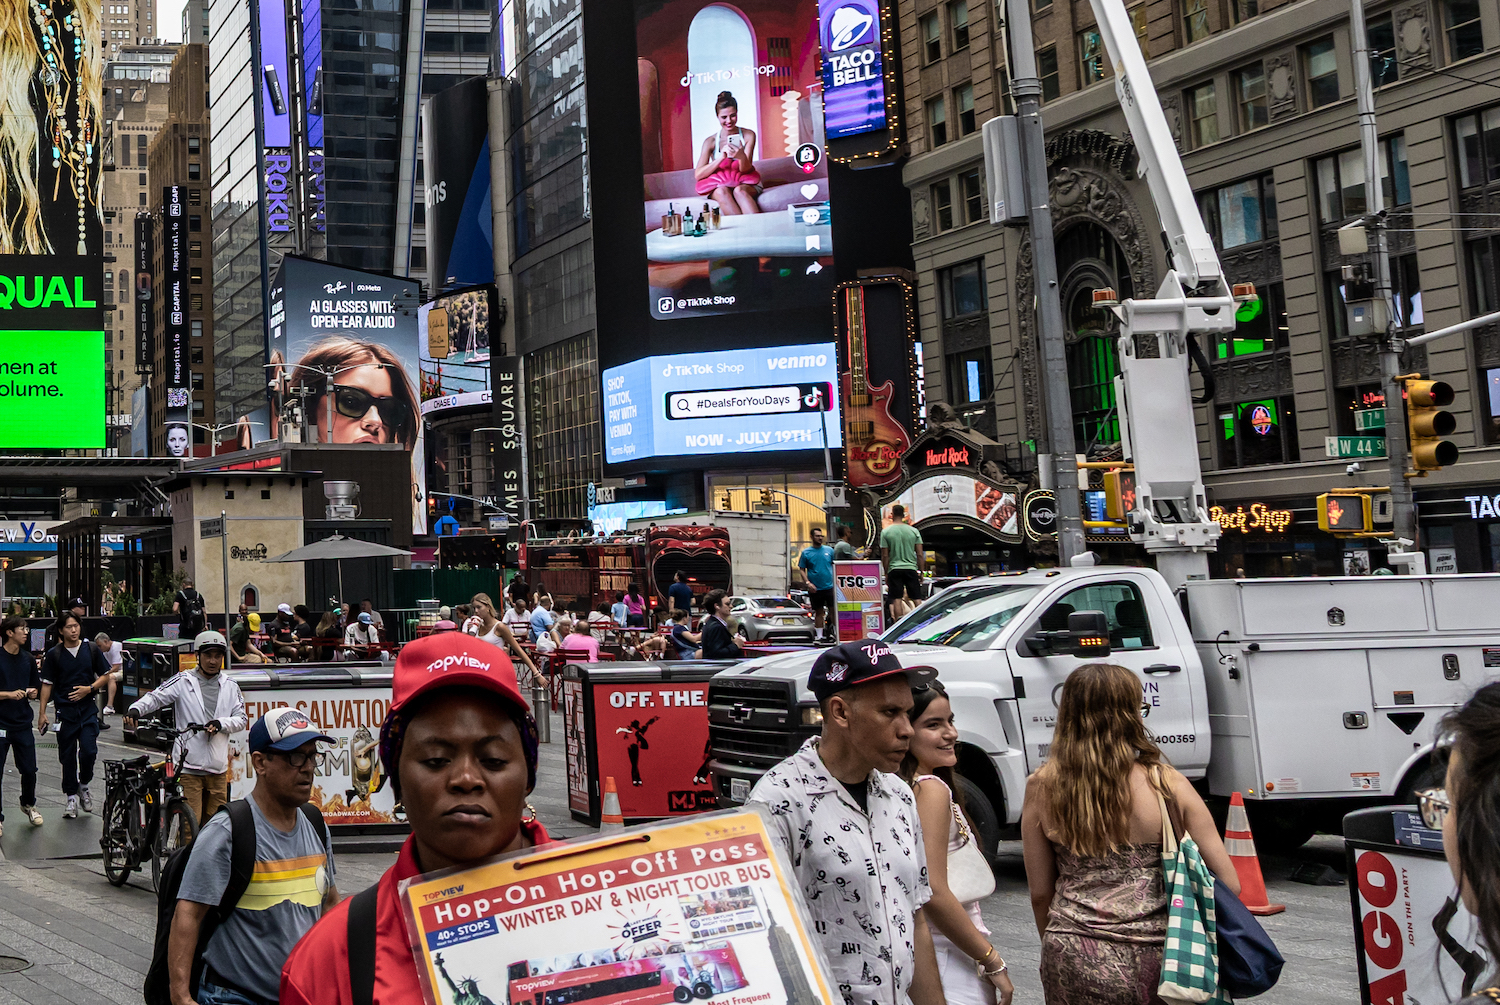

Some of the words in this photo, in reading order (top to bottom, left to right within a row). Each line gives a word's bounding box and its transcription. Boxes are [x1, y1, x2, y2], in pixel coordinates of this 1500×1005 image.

[829, 50, 875, 73] TACO
[695, 68, 740, 85] TikTok
[743, 64, 775, 77] Shop
[833, 65, 876, 87] BELL
[266, 155, 291, 232] ROKU
[310, 300, 320, 313] AI
[322, 300, 367, 313] GLASSES
[369, 300, 396, 313] WITH
[677, 297, 713, 309] @TikTok
[714, 294, 736, 307] Shop
[311, 316, 363, 329] OPEN-EAR
[364, 316, 396, 328] AUDIO
[38, 359, 58, 375] at
[675, 364, 714, 376] TikTok
[717, 363, 745, 374] Shop
[767, 354, 827, 370] venmo
[607, 376, 625, 391] SHOP
[433, 398, 451, 409] CHASE
[608, 390, 632, 407] TIKTOK,
[697, 395, 791, 409] #DealsForYouDays
[500, 372, 516, 449] SQUARE
[609, 408, 620, 422] PAY
[621, 405, 637, 419] WITH
[610, 422, 632, 438] VENMO
[685, 434, 724, 447] NOW
[735, 431, 772, 445] JULY
[775, 429, 812, 443] 19TH
[850, 447, 880, 461] Hard
[1340, 439, 1351, 455] W
[1357, 439, 1372, 455] 44
[926, 447, 948, 466] Hard
[948, 445, 969, 467] Rock
[596, 487, 616, 503] AT&T
[1209, 506, 1248, 533] Rock
[1249, 503, 1291, 532] Shop
[20, 522, 59, 543] YOR
[507, 541, 519, 551] 3
[837, 576, 864, 588] TSQ
[610, 691, 655, 708] OFF.
[659, 690, 707, 707] THE.
[245, 700, 290, 731] FIN
[671, 793, 696, 809] MJ
[700, 797, 716, 805] THE
[434, 883, 546, 924] Hop-On
[558, 848, 678, 893] Hop-Off
[692, 841, 757, 868] Pass
[1401, 867, 1411, 898] PARTY
[422, 884, 464, 901] TOPVIEW
[500, 904, 567, 932] WINTER
[571, 895, 605, 917] DAY
[610, 892, 622, 907] &
[626, 880, 681, 904] NIGHT
[684, 871, 733, 892] TOUR
[736, 863, 771, 883] BUS
[1405, 900, 1413, 919] THE
[642, 914, 659, 923] MINUTE
[437, 930, 455, 941] 40+
[457, 920, 490, 935] STOPS
[621, 920, 663, 939] OFFER
[1407, 920, 1415, 946] JOIN
[841, 942, 861, 954] AH!
[516, 979, 555, 993] TOPVIEW
[732, 992, 771, 1005] Frequent
